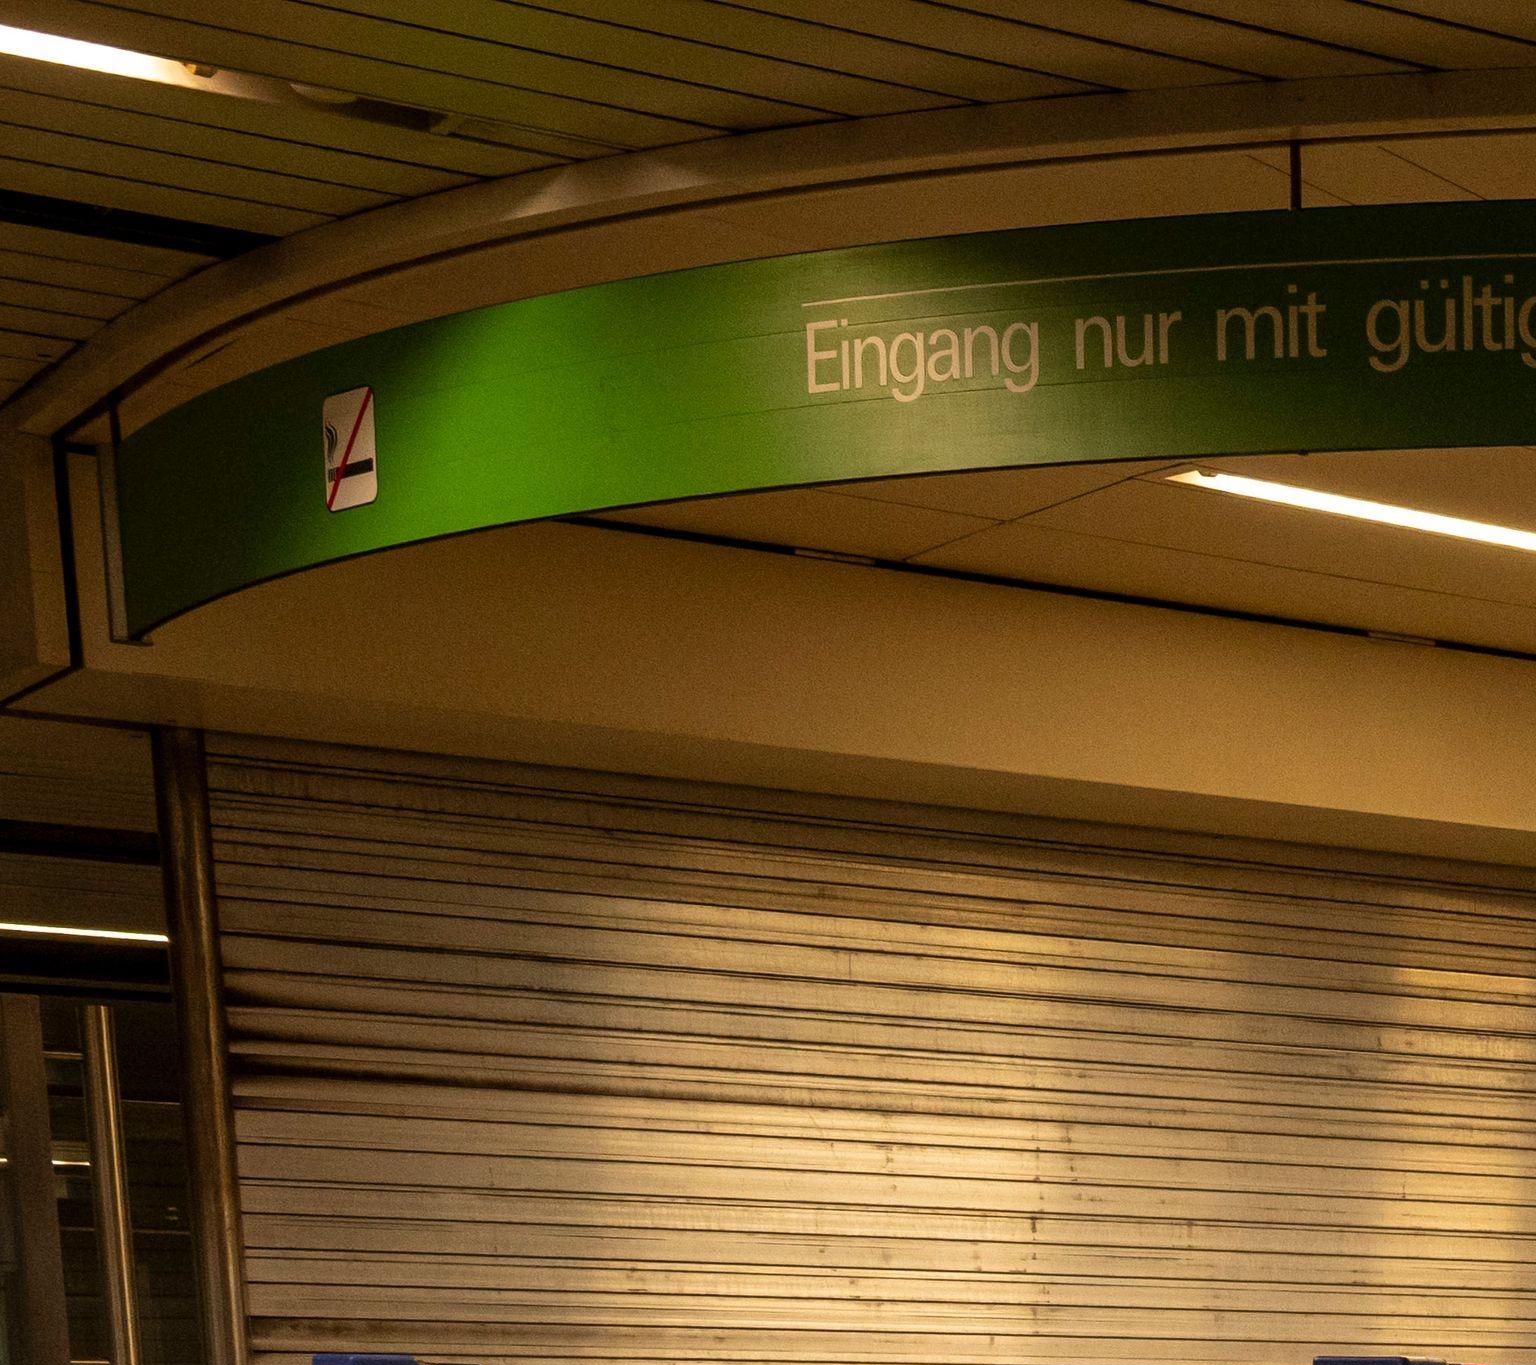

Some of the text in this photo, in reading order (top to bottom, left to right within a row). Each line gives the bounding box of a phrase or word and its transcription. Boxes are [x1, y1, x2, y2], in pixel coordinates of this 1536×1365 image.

[805, 316, 1039, 403] Eingang
[1073, 309, 1182, 370] nur
[1215, 283, 1327, 361] mit
